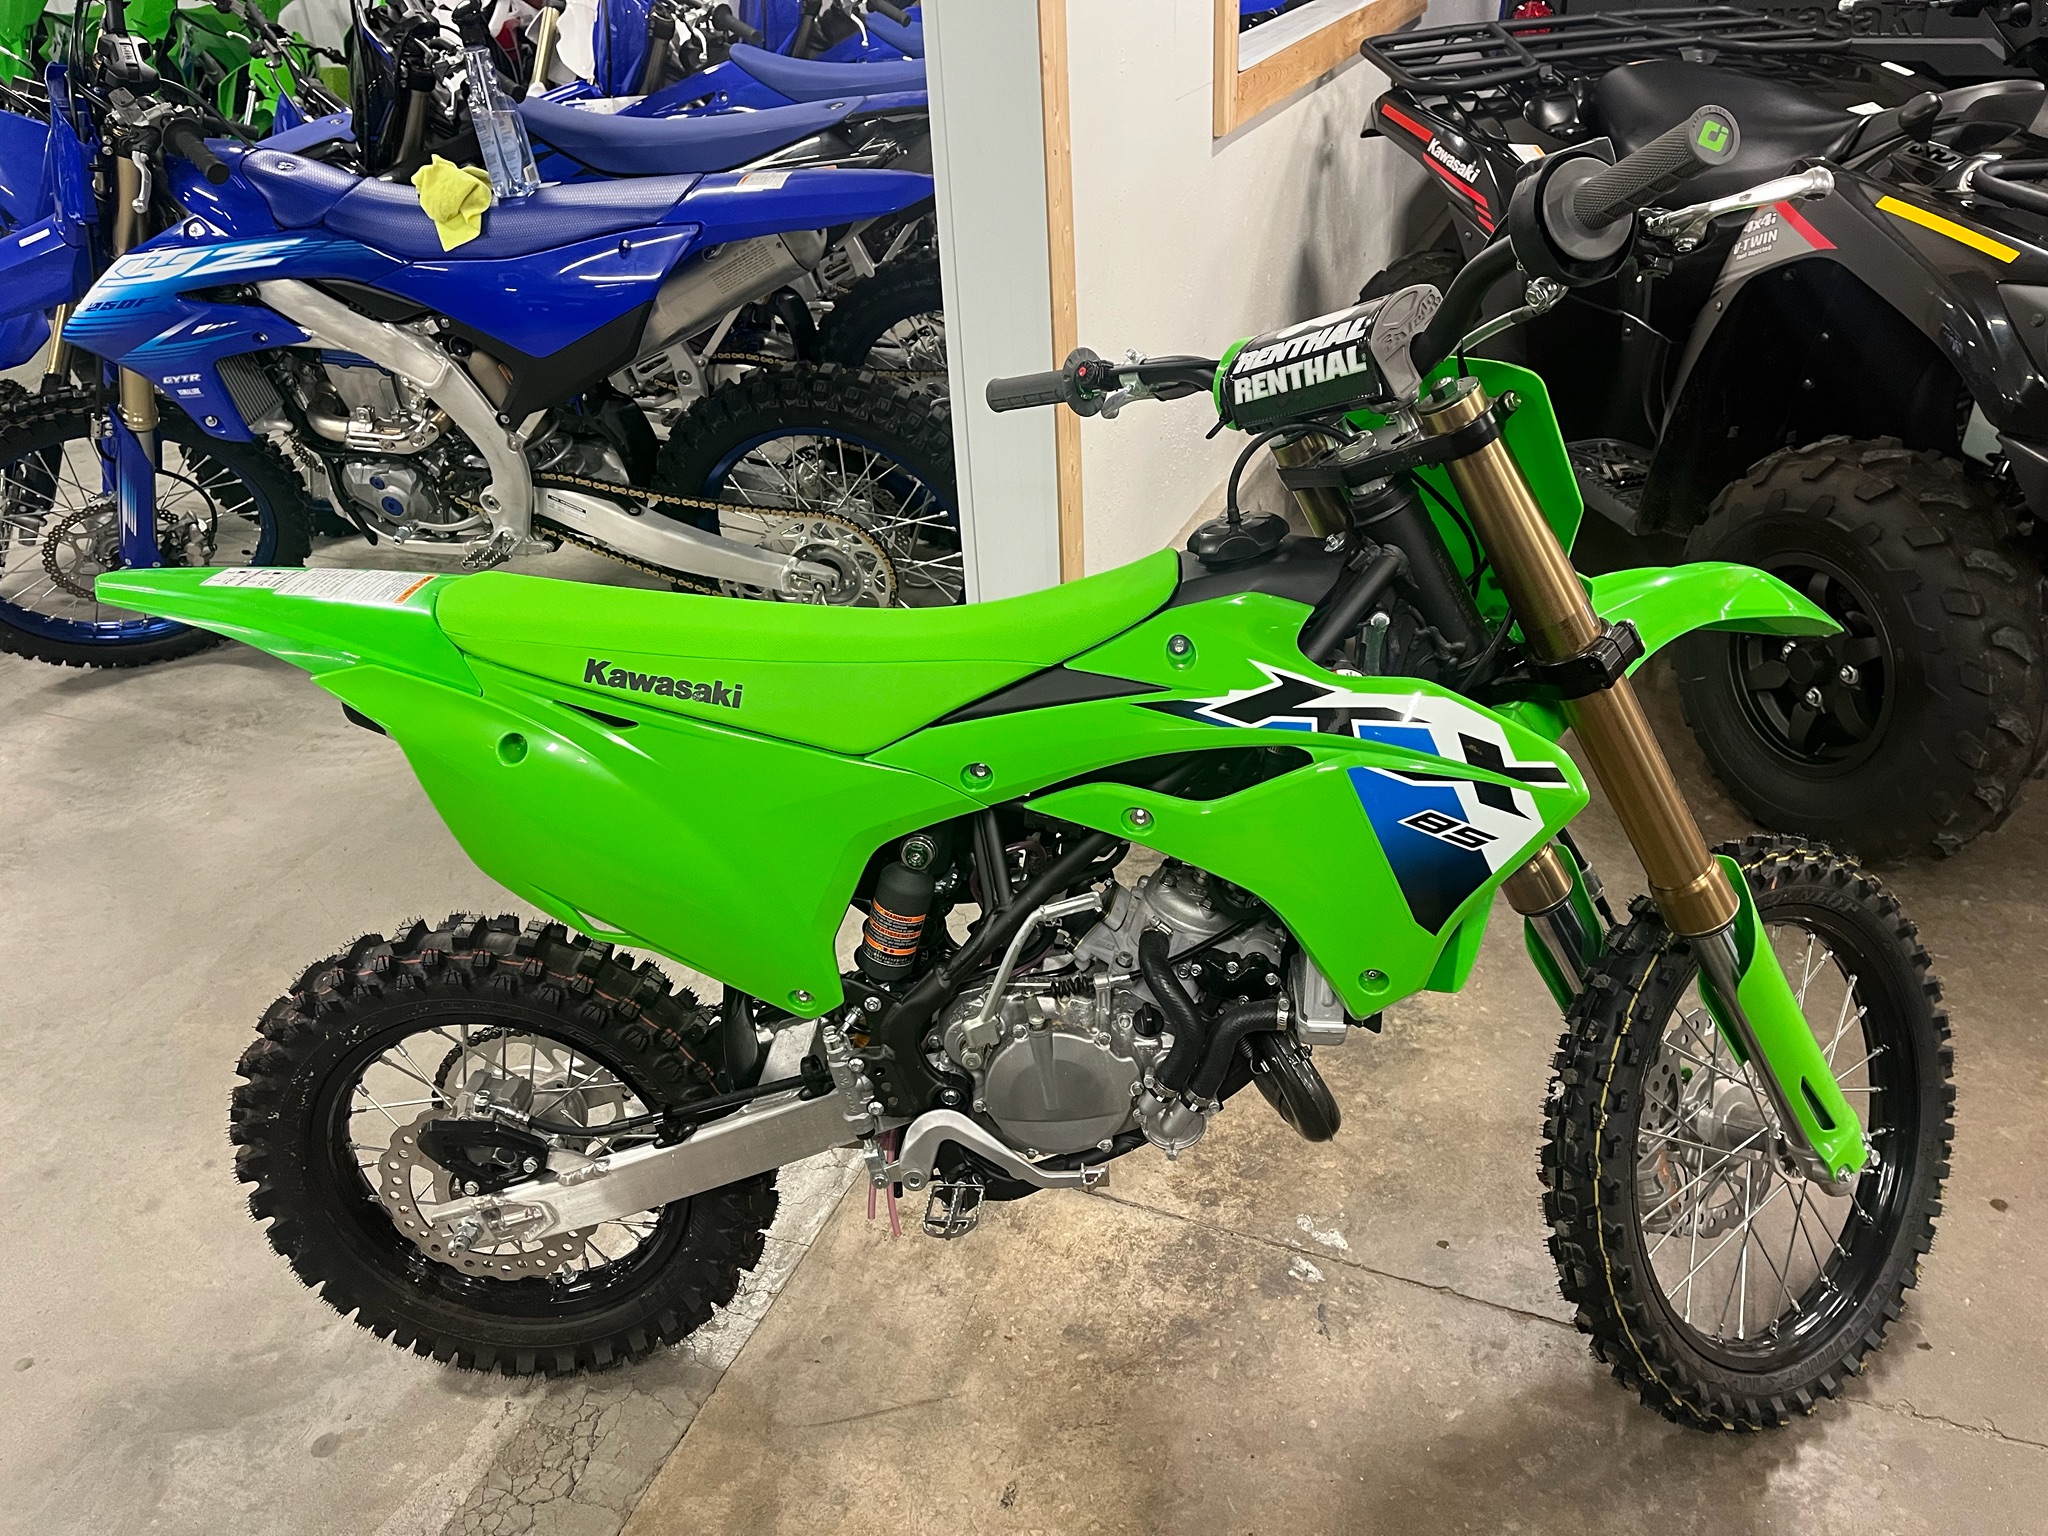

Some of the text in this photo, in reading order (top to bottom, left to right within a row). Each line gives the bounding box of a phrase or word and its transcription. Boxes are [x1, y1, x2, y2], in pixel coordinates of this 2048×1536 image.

[1427, 137, 1481, 184] Kawasaki
[1733, 228, 1778, 255] V-TWIN
[85, 296, 160, 312] 250F
[1232, 315, 1368, 375] RENTHAL
[163, 373, 202, 384] GYTR
[1234, 345, 1368, 406] RENTHAL
[584, 658, 744, 709] Kawasaki
[1402, 810, 1499, 850] 85
